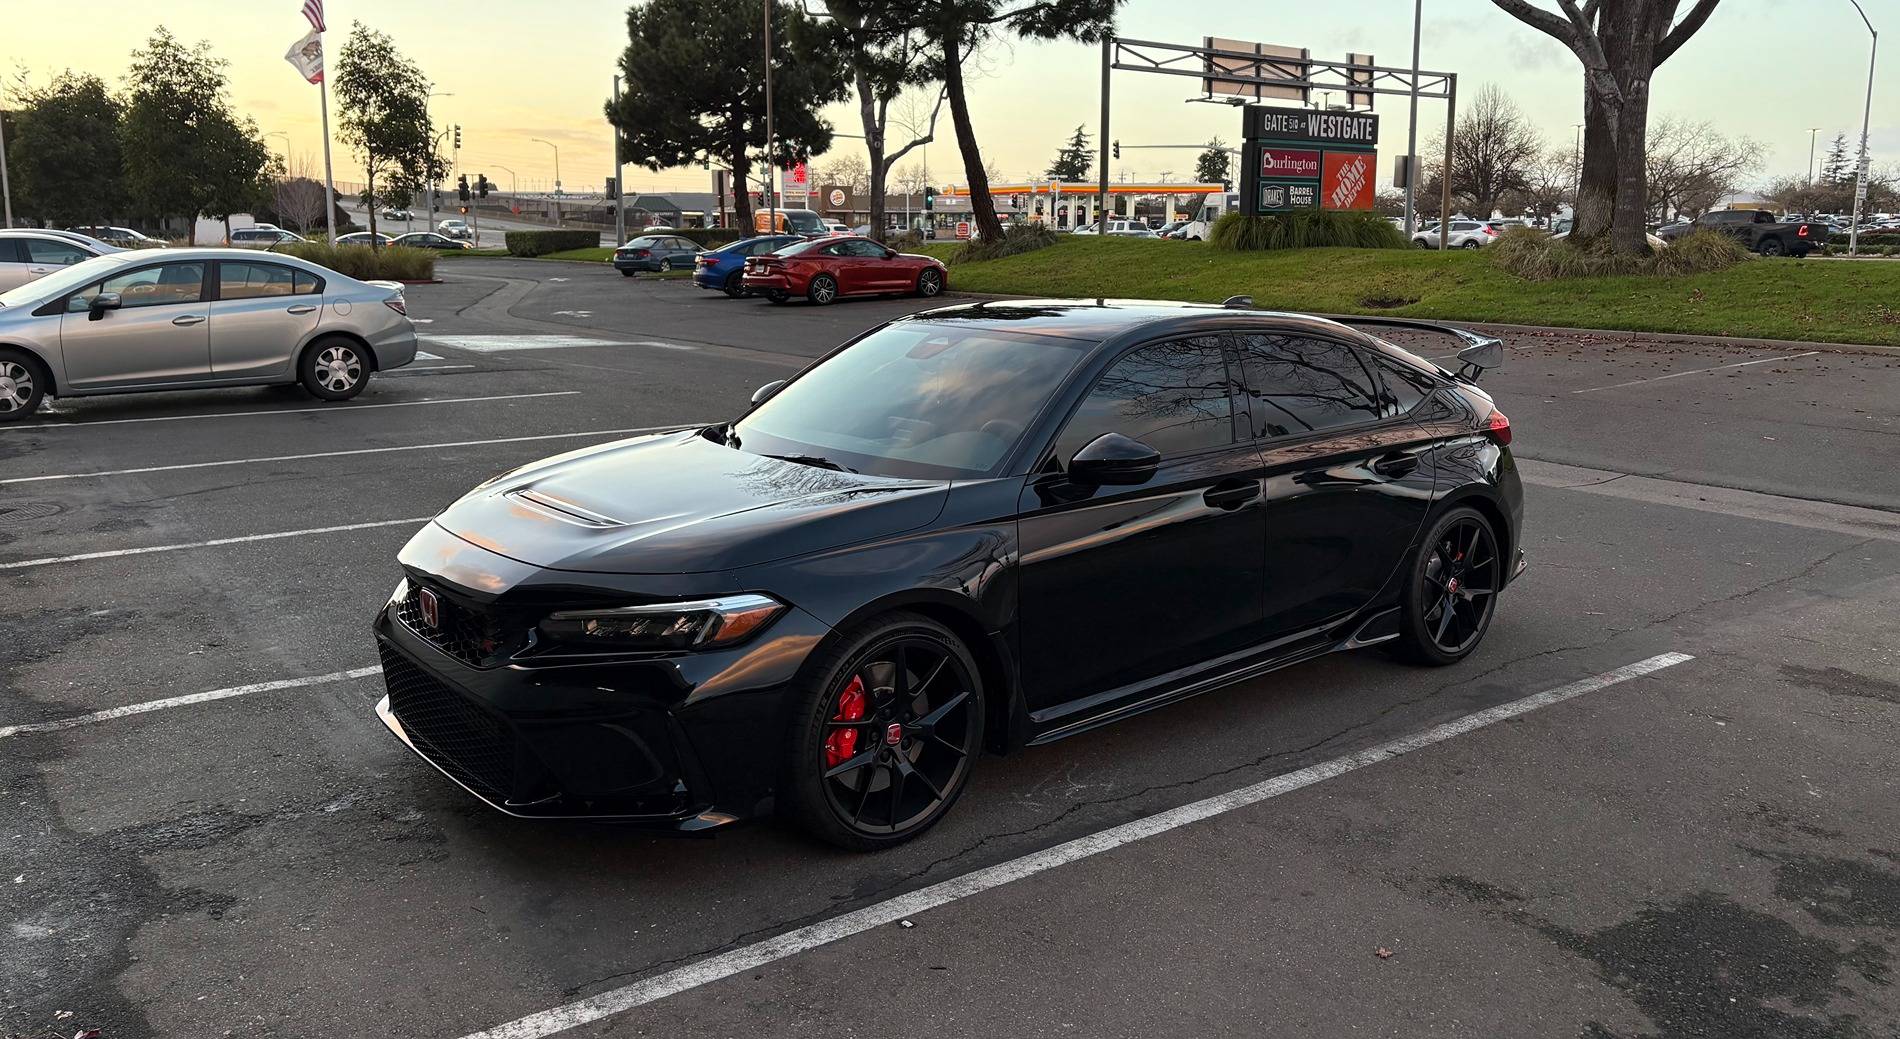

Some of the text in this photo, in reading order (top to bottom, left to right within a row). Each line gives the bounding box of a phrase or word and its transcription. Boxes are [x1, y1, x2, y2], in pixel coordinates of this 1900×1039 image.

[1264, 113, 1288, 132] GATE
[1307, 113, 1373, 140] WESTGATE
[1263, 152, 1318, 173] Burlington
[1336, 160, 1351, 181] THE
[1289, 185, 1314, 196] BARREL
[1331, 155, 1367, 209] HOME
[1344, 176, 1367, 209] DEPOT
[1290, 195, 1312, 205] HOUSE
